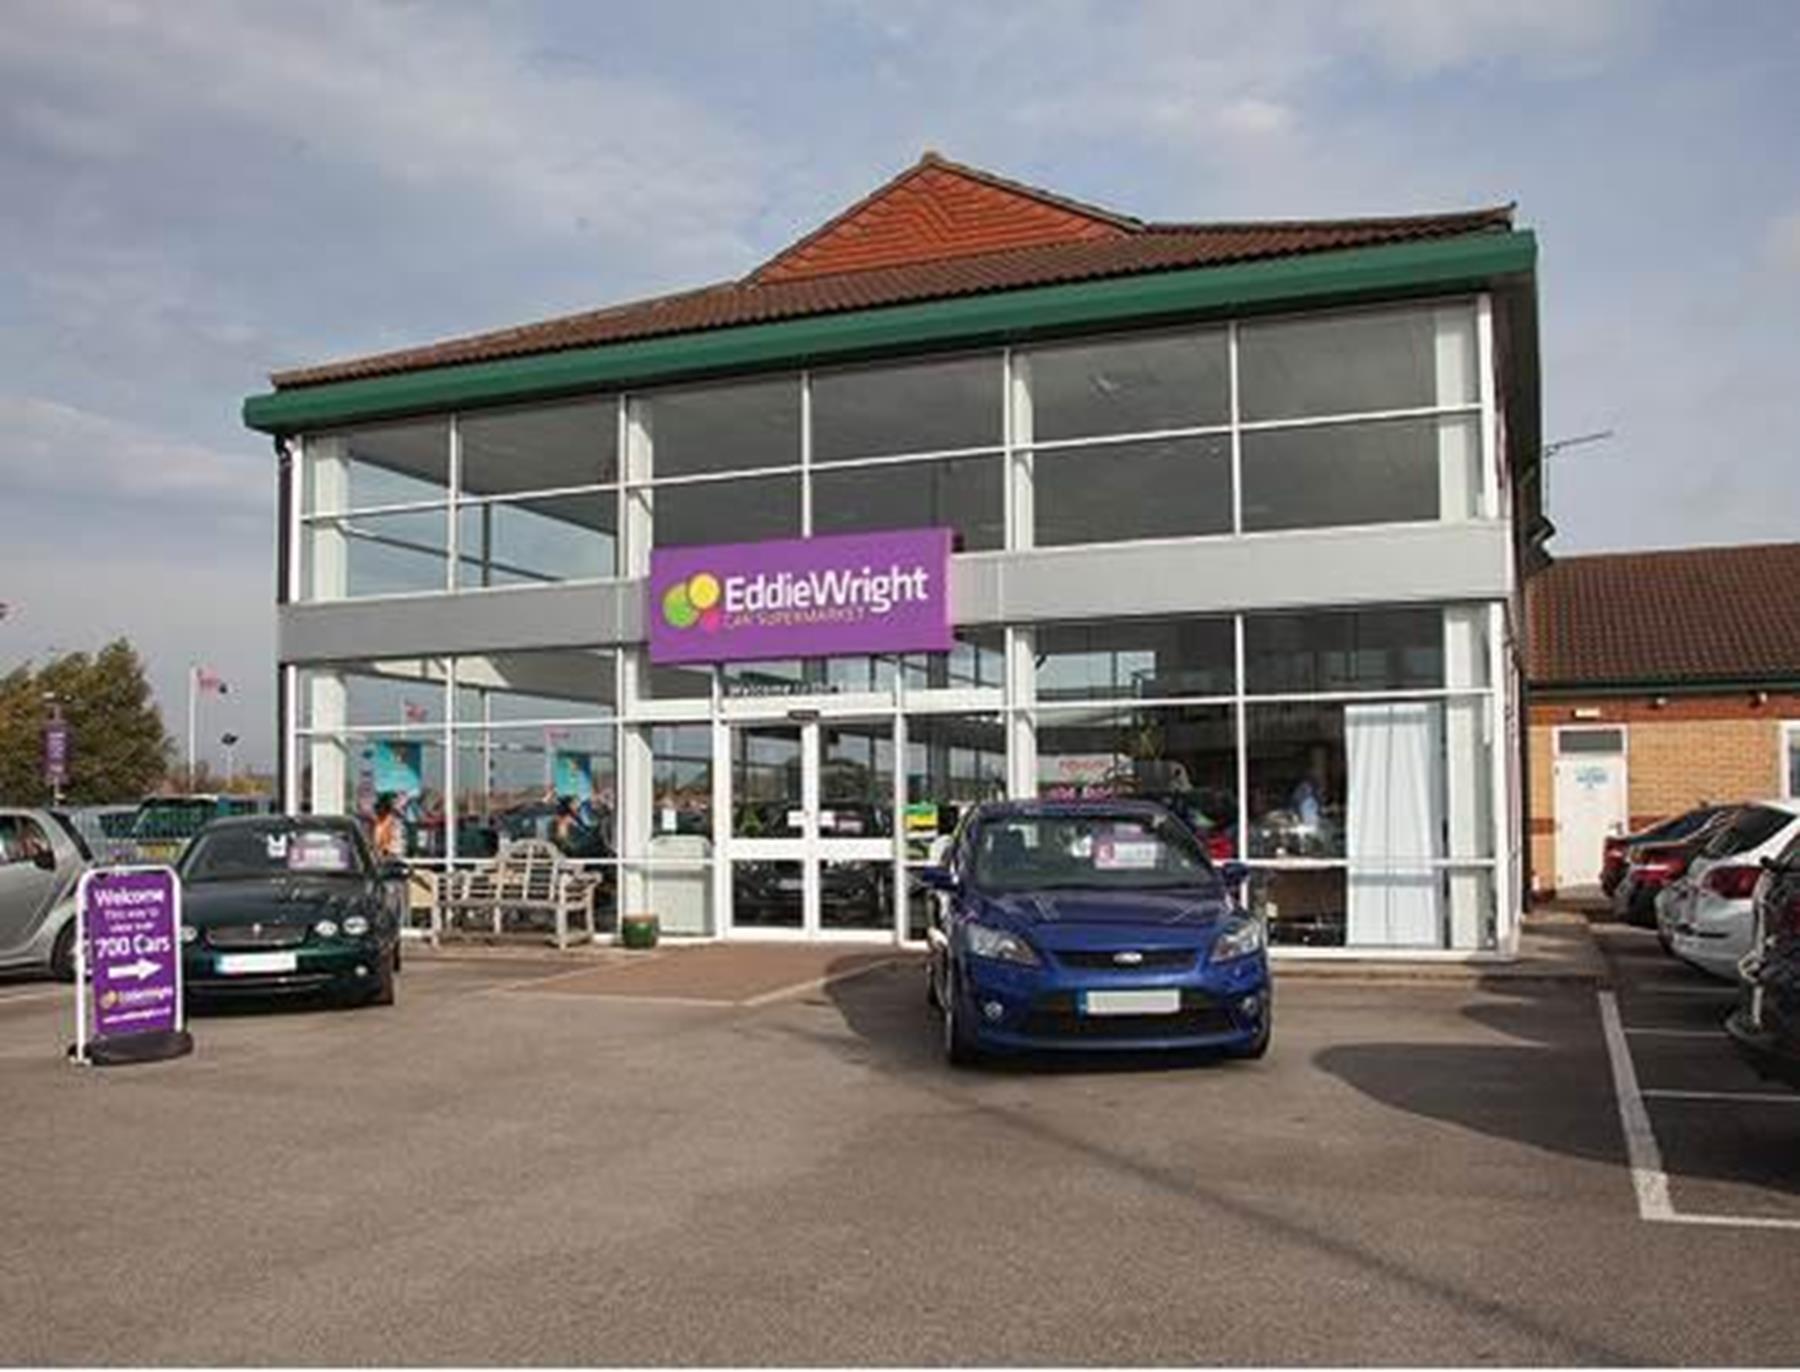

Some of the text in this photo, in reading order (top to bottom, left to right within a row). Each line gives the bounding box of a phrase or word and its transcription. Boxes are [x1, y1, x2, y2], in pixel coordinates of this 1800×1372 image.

[725, 566, 929, 614] EddieWright
[94, 887, 165, 907] Welcome
[95, 933, 172, 959] 700 Cars
